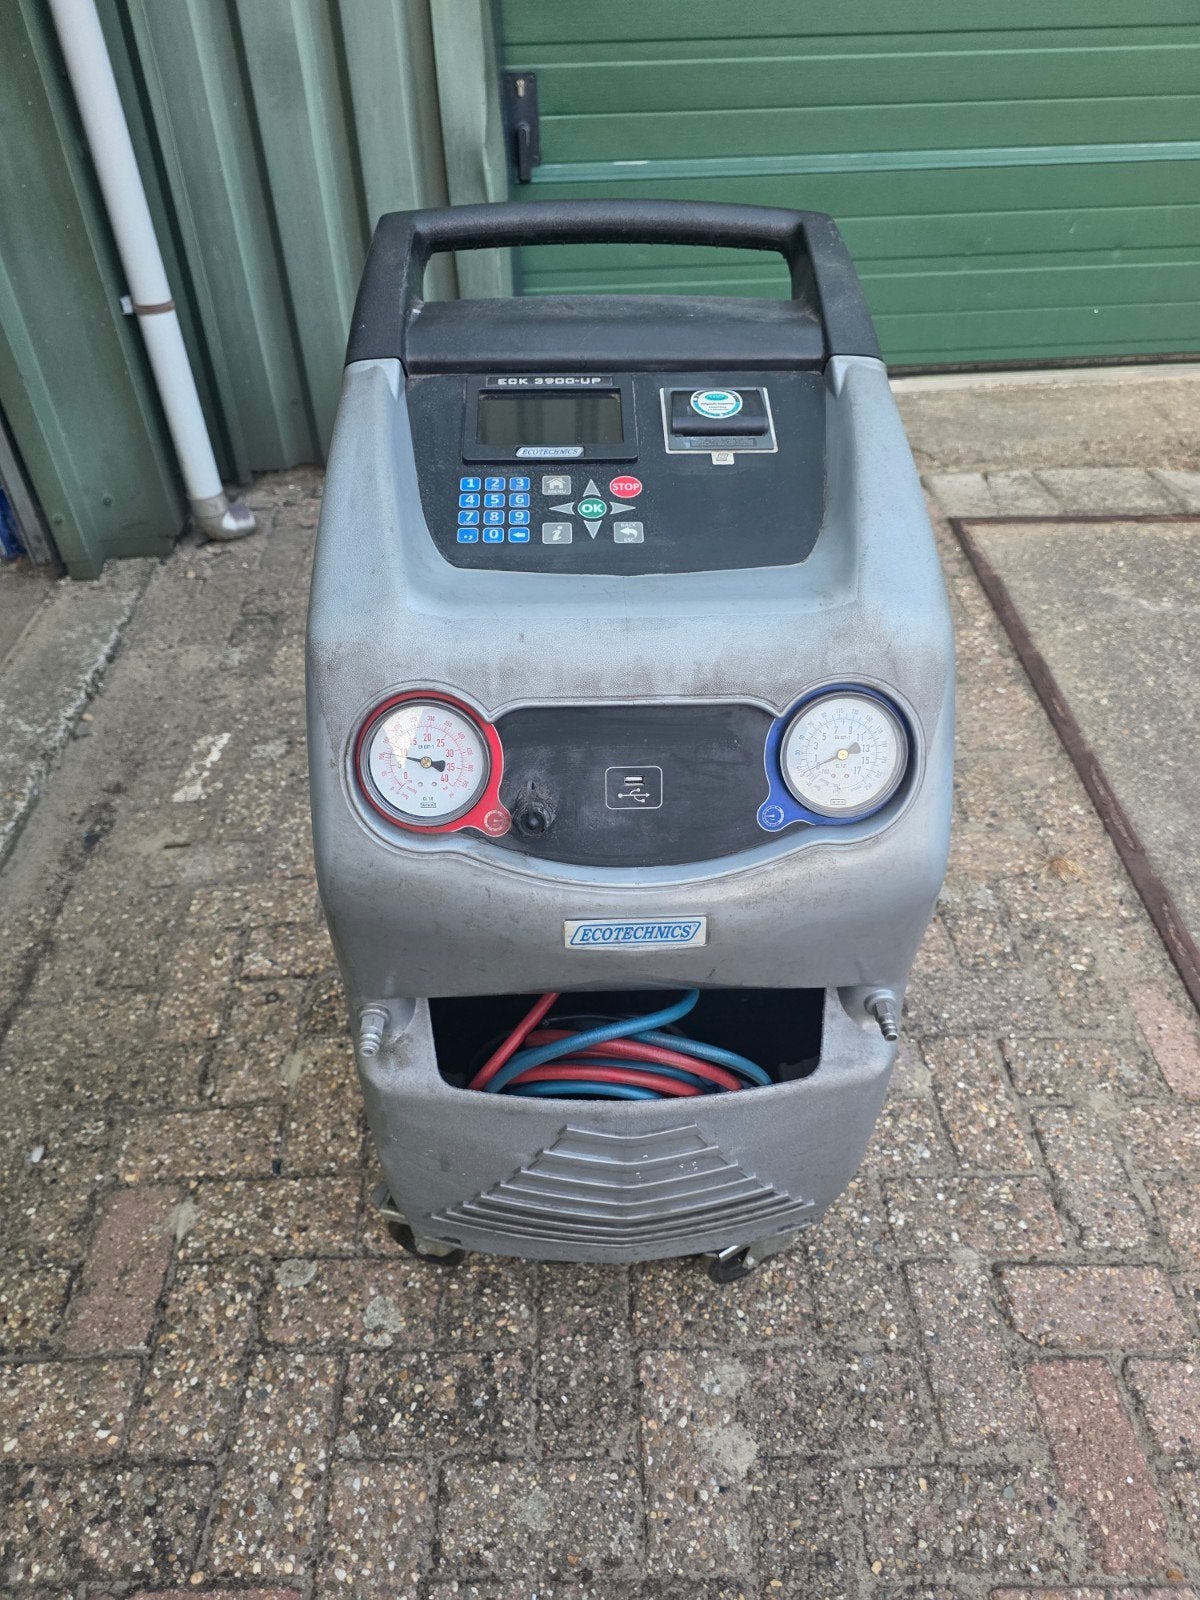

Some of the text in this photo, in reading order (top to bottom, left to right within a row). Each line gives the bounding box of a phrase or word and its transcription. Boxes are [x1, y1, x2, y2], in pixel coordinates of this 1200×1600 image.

[498, 377, 602, 385] ECK 3900-UP
[520, 448, 579, 456] ECOTECHNICS
[466, 478, 525, 488] 1 2 3
[612, 482, 640, 491] STOP
[465, 494, 525, 504] 4 5 6
[581, 503, 603, 513] OK
[464, 511, 524, 521] 7 8 9
[488, 529, 499, 539] 0
[423, 733, 432, 742] 20
[436, 738, 445, 748] 25
[445, 748, 454, 758] 30
[862, 744, 870, 753] 13
[861, 756, 870, 765] 15
[446, 762, 456, 772] 35
[853, 765, 862, 775] 17
[440, 774, 449, 783] 40
[580, 925, 692, 942] ECOTECHNICS
